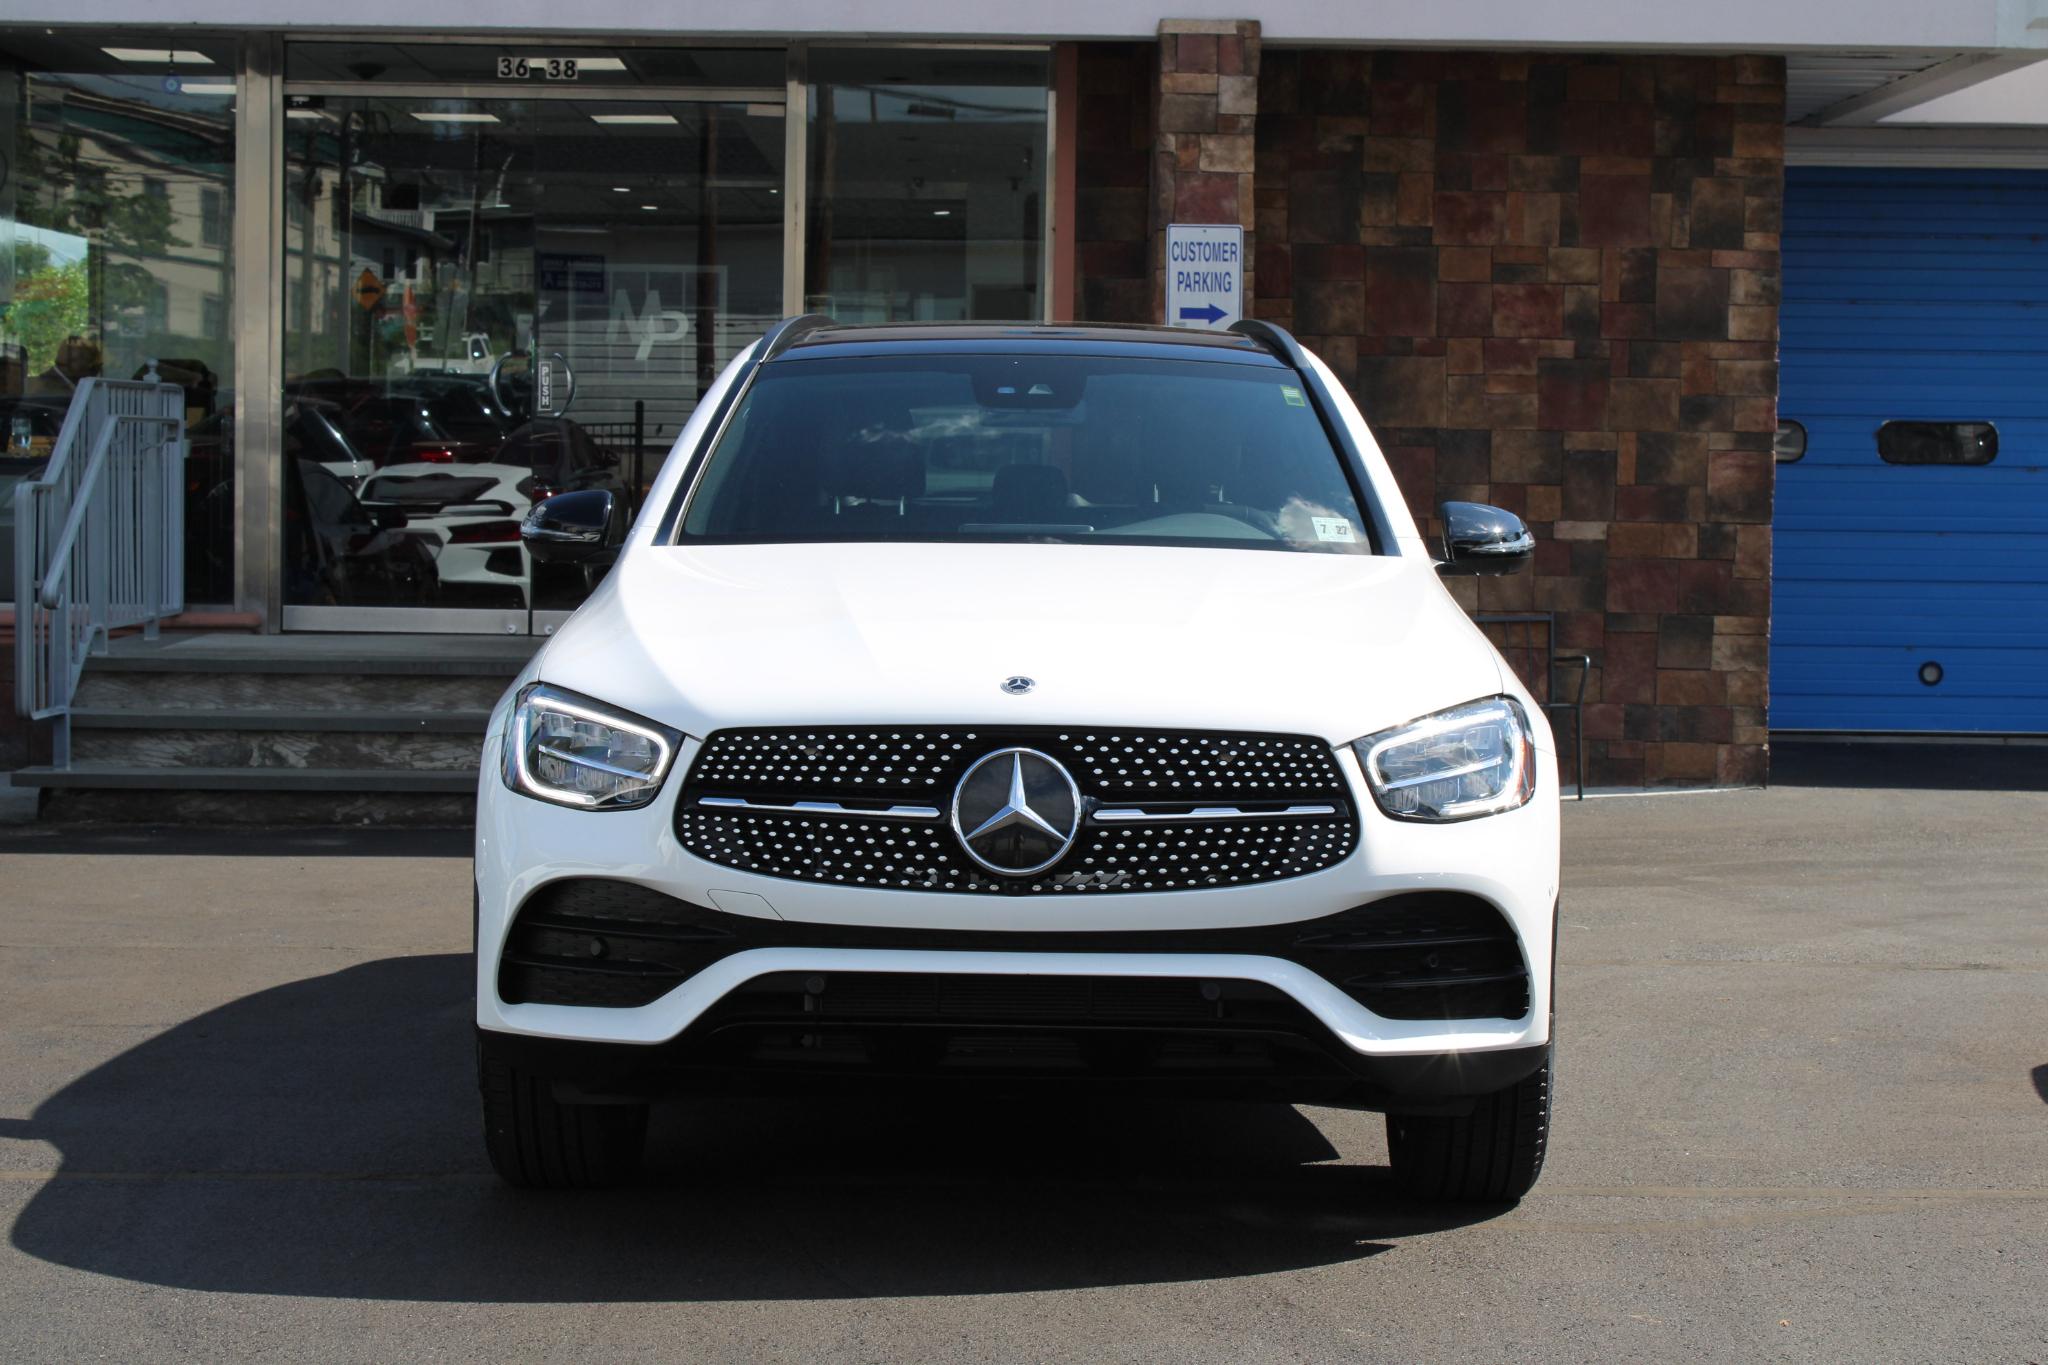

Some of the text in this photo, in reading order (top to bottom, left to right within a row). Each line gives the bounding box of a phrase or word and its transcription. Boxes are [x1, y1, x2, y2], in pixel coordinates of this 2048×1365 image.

[1171, 241, 1238, 262] CUSTOMER
[1177, 271, 1232, 293] PARKING
[541, 366, 550, 406] PUSH
